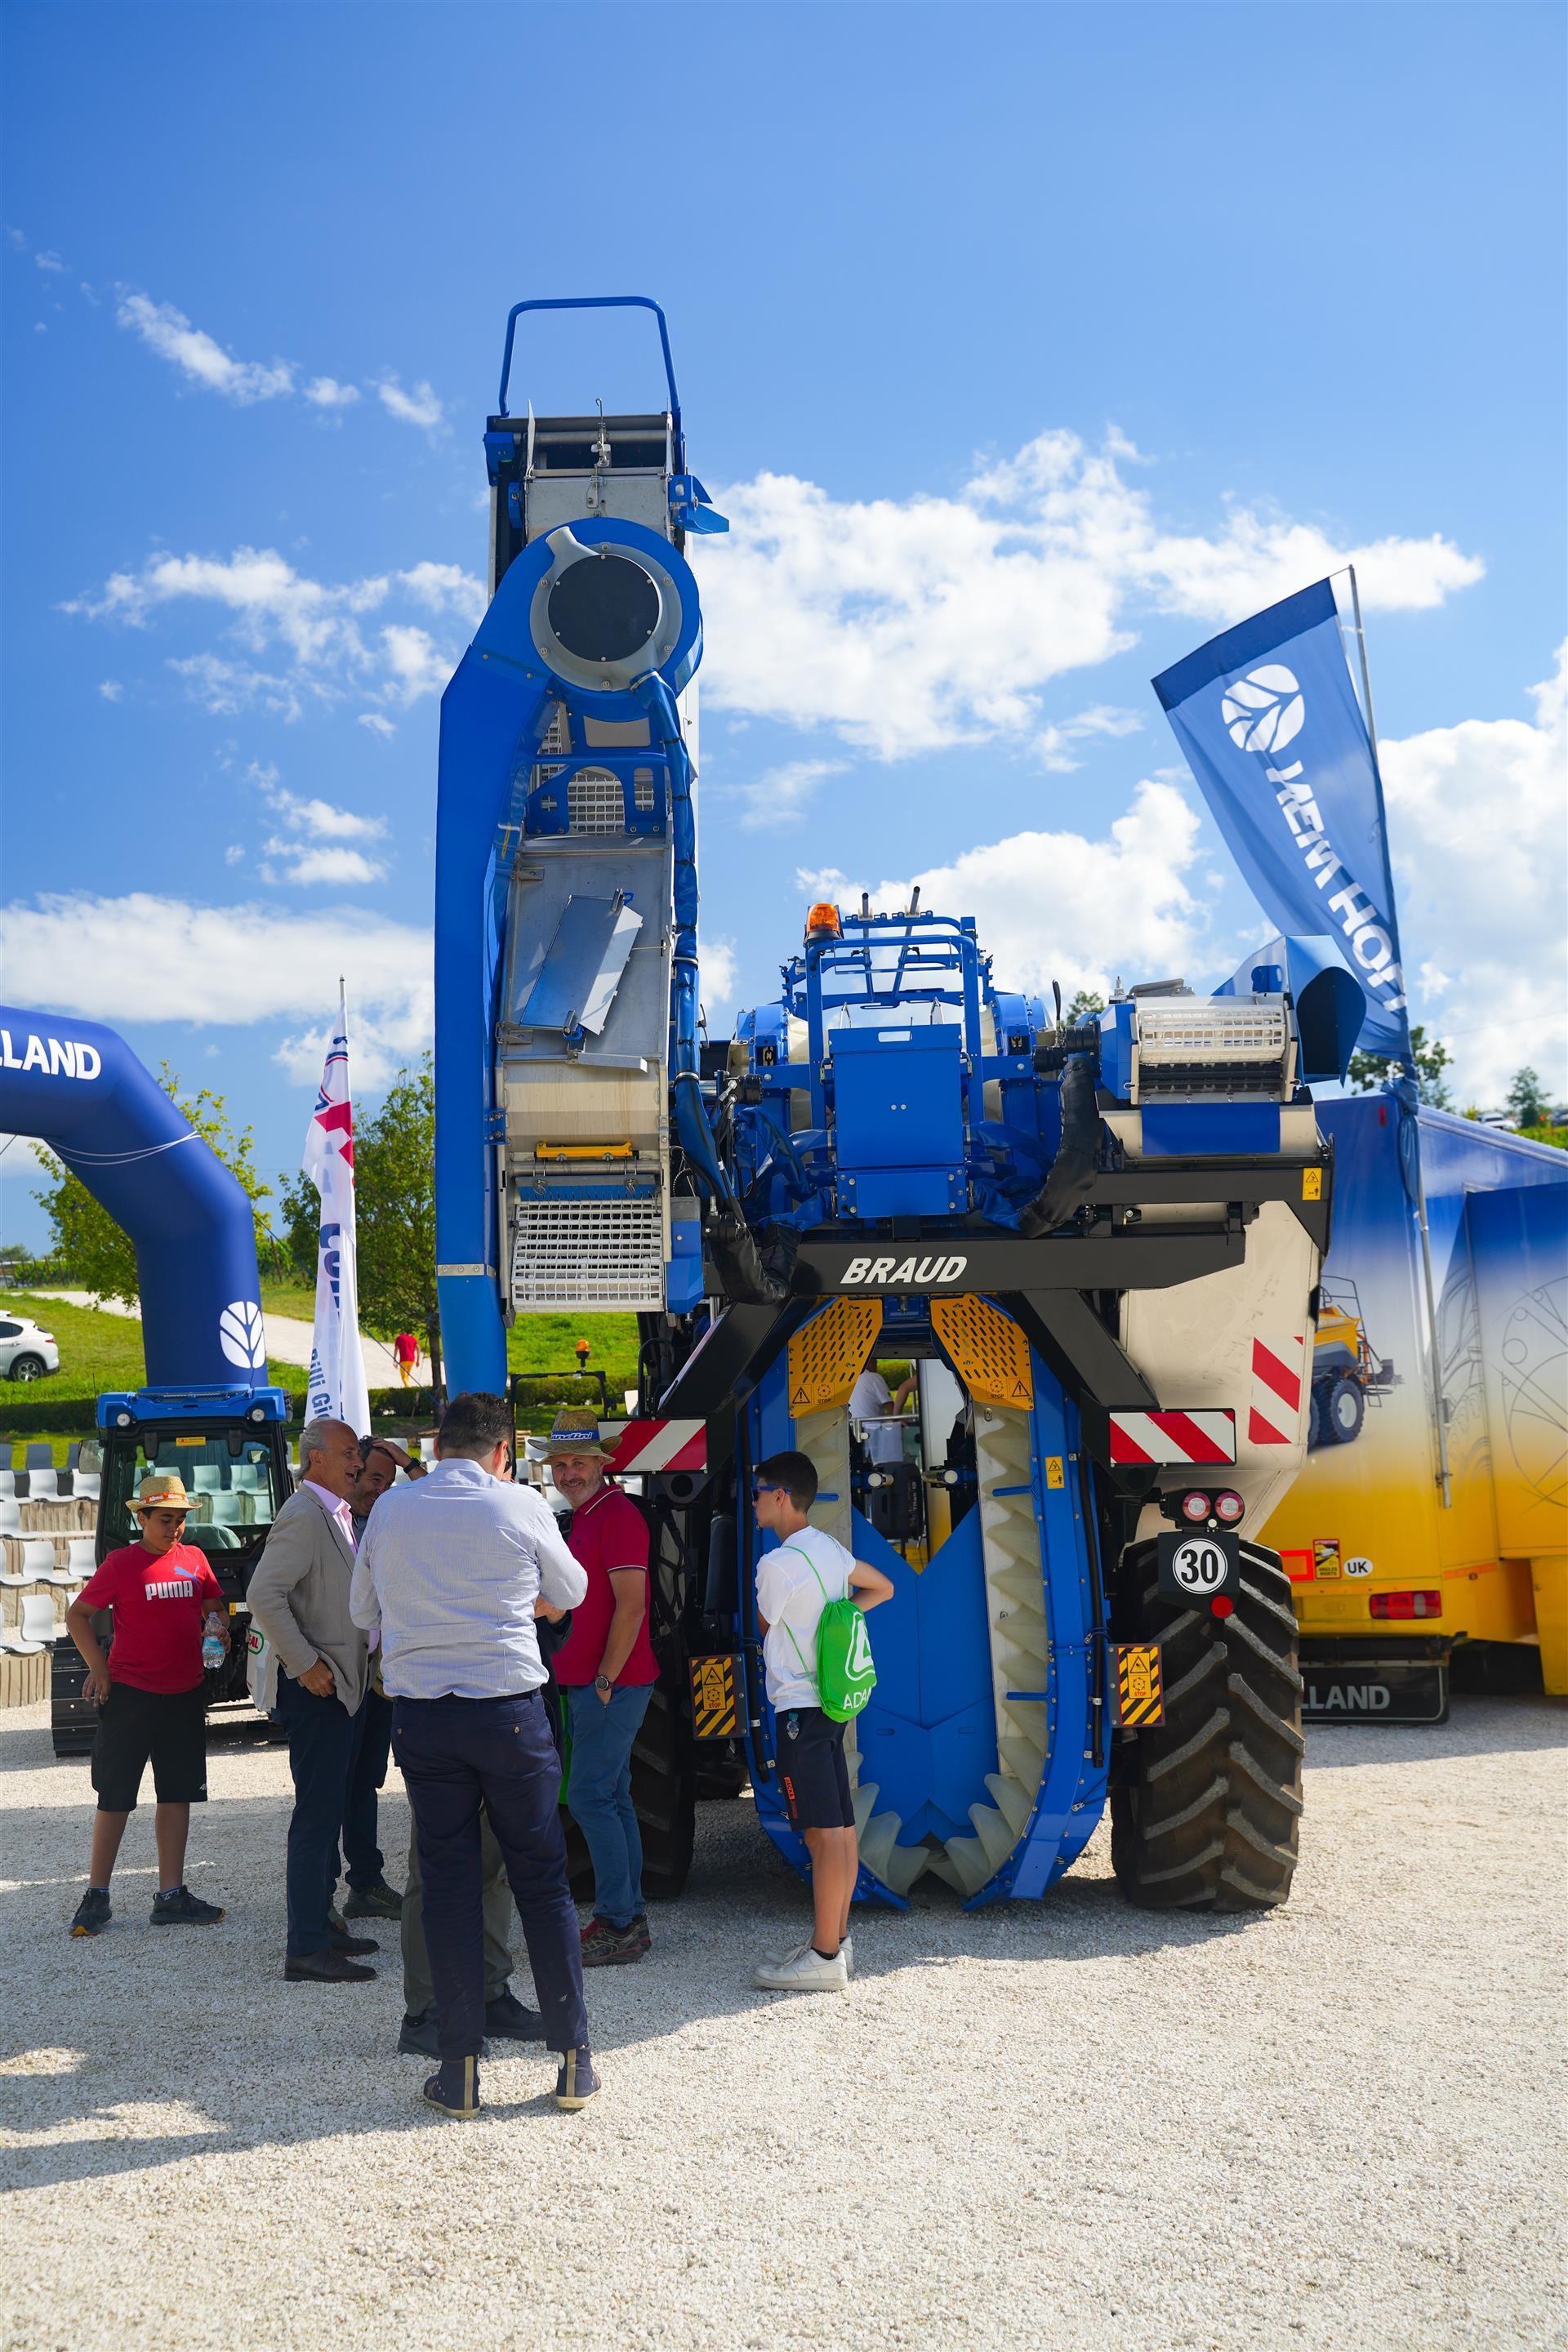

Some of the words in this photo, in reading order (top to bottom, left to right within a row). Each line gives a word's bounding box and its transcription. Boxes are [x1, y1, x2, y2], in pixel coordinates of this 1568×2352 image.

[0, 1030, 101, 1080] LAND
[840, 1256, 968, 1285] BRAUD
[551, 1432, 593, 1441] andini
[1181, 1548, 1218, 1584] 30
[1347, 1561, 1369, 1574] UK
[145, 1580, 194, 1601] PUMA
[1301, 1685, 1391, 1710] LAND
